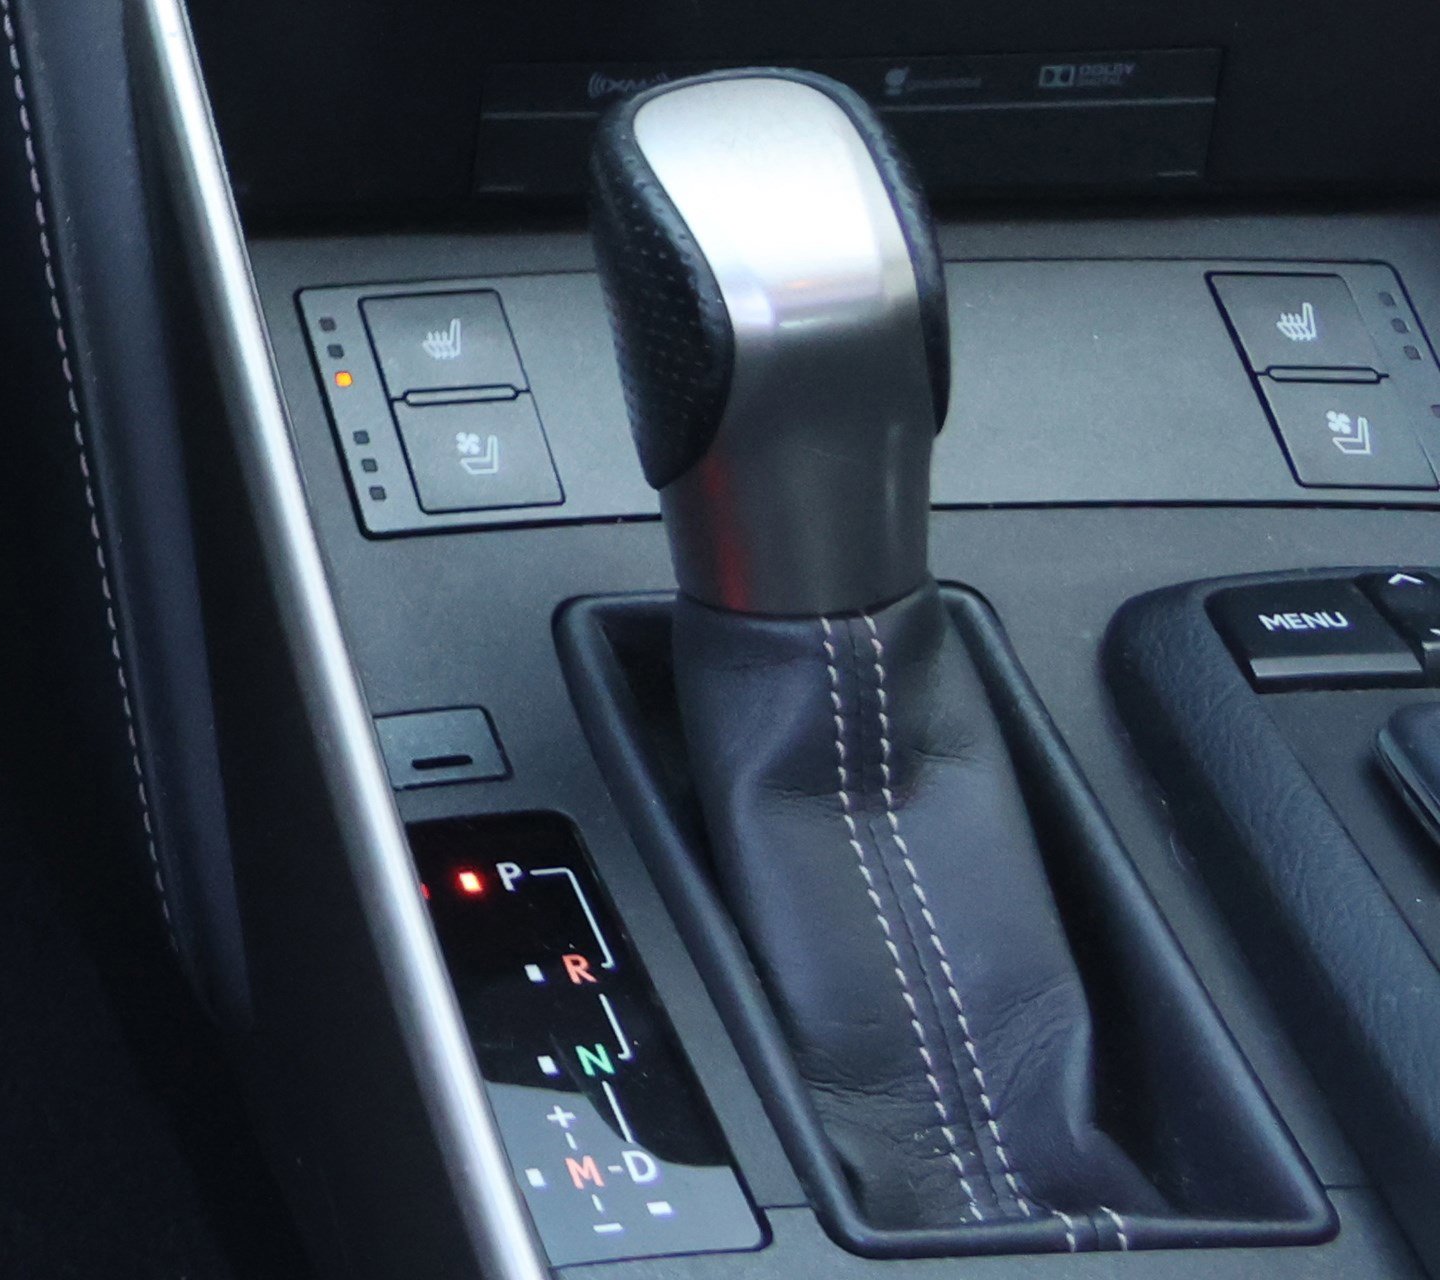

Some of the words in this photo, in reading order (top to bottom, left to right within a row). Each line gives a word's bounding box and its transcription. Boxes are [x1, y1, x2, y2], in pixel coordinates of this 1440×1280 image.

[1258, 610, 1350, 634] MENU
[496, 861, 523, 893] P
[561, 953, 598, 984] R
[575, 1044, 615, 1077] N
[565, 1156, 606, 1190] M
[621, 1150, 660, 1185] D
